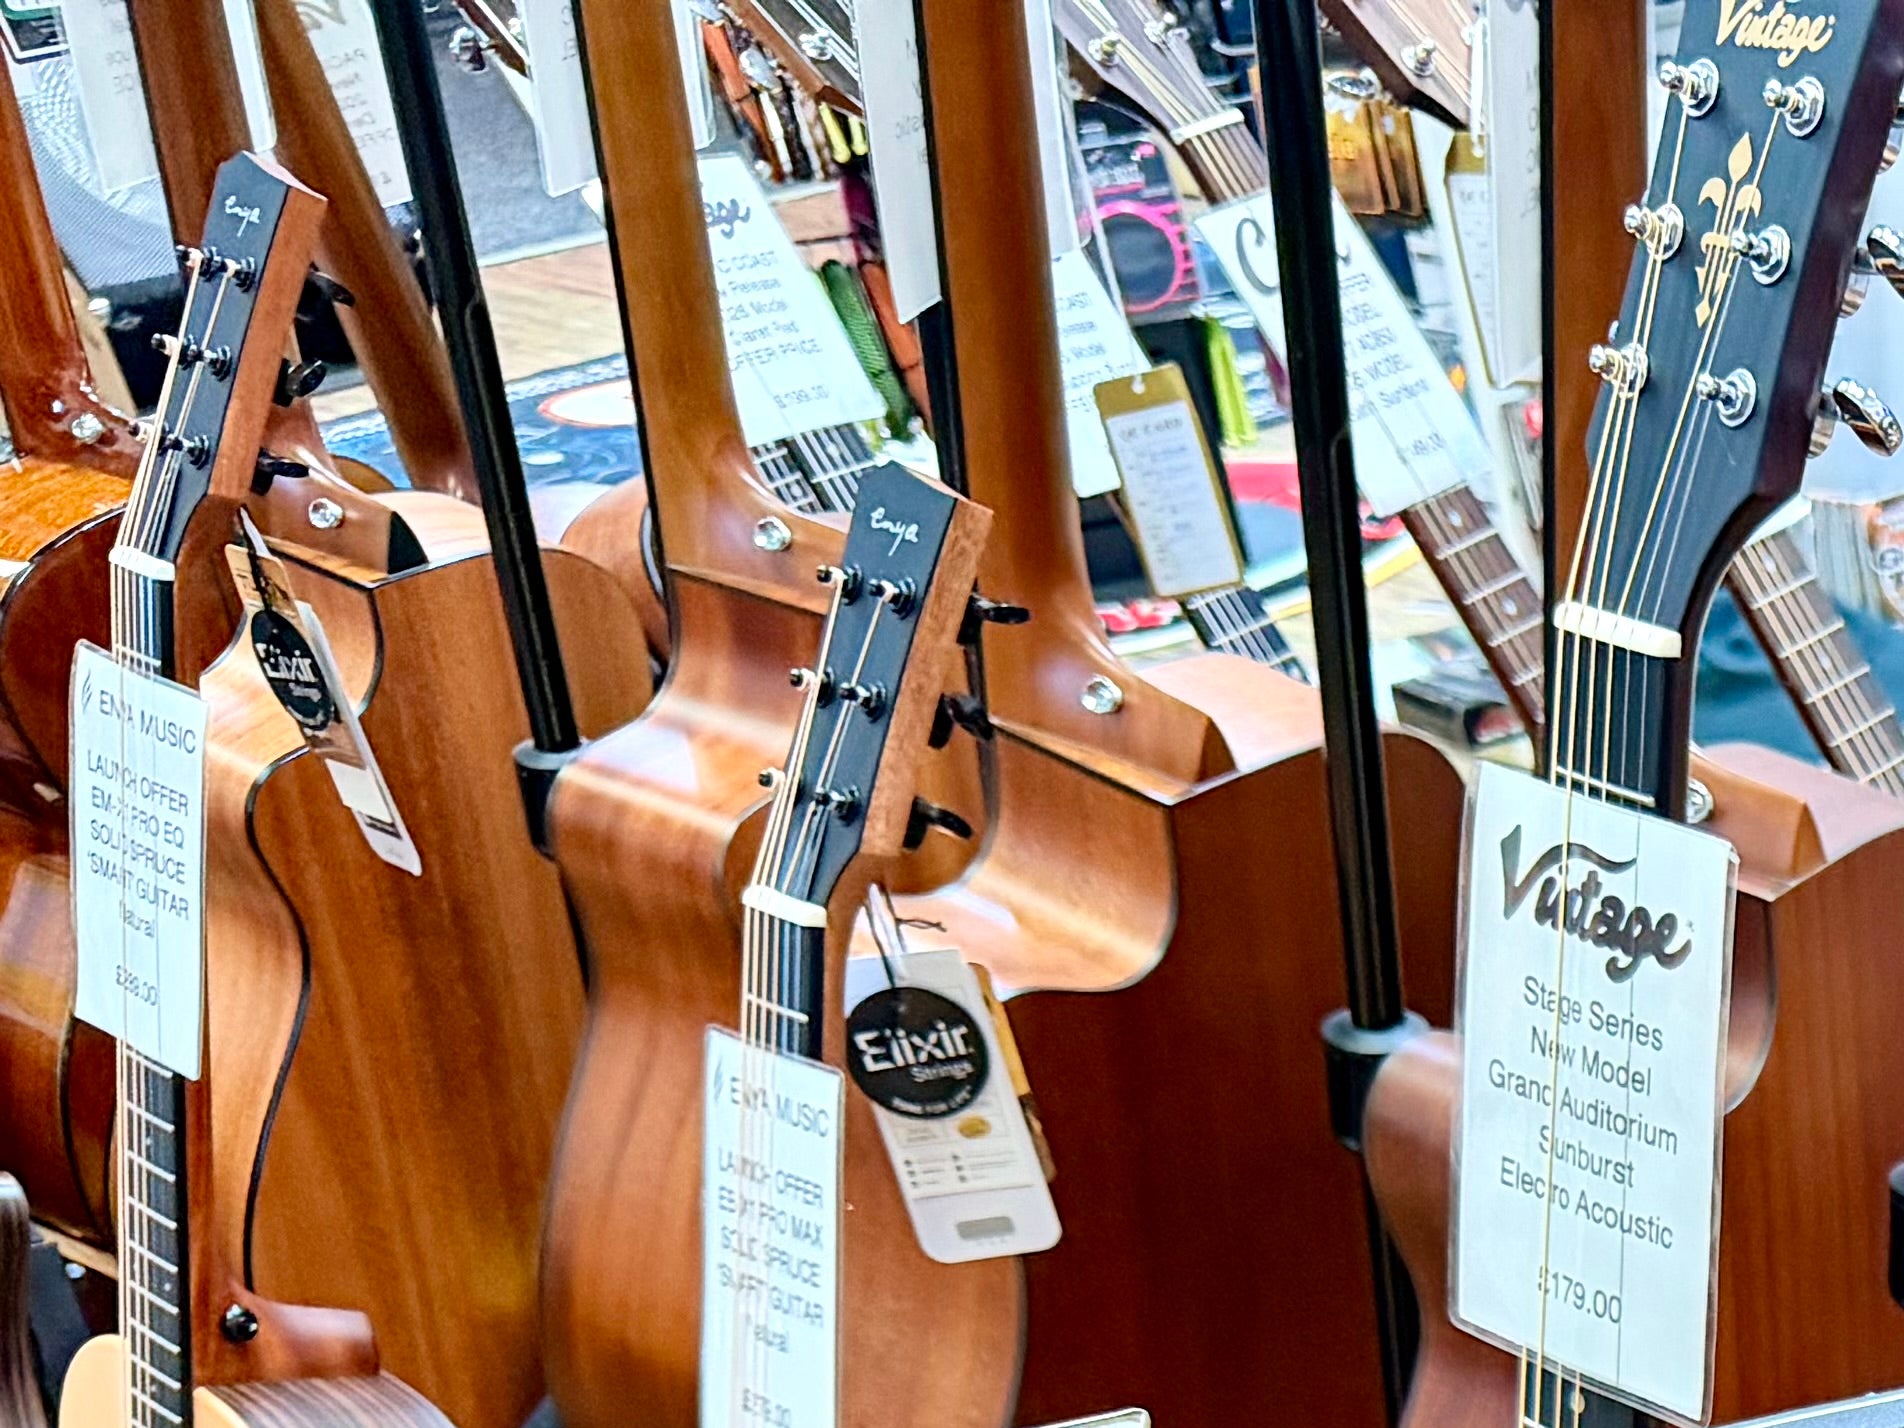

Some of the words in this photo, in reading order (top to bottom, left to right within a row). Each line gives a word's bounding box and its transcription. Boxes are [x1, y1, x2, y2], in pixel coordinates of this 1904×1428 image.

[1716, 0, 1834, 68] Vintage
[100, 689, 136, 730] ENA
[140, 709, 197, 754] MUSIC
[131, 805, 160, 838] PRO
[163, 820, 185, 850] EQ
[140, 776, 190, 817] OFFER
[130, 838, 186, 885] SPRUCE
[136, 877, 190, 921] GUITAR
[1500, 823, 1693, 984] Vintage
[853, 1019, 970, 1073] Elixir
[1523, 976, 1583, 1026] Stage
[1588, 1001, 1664, 1052] Series
[1531, 1026, 1576, 1068] New
[1582, 1046, 1652, 1097] Model
[776, 1093, 830, 1138] MUSIC
[1560, 1087, 1678, 1155] Auditorium
[1539, 1125, 1635, 1189] Sunburst
[1500, 1156, 1571, 1211] Elecro
[1575, 1190, 1674, 1250] Acoustic
